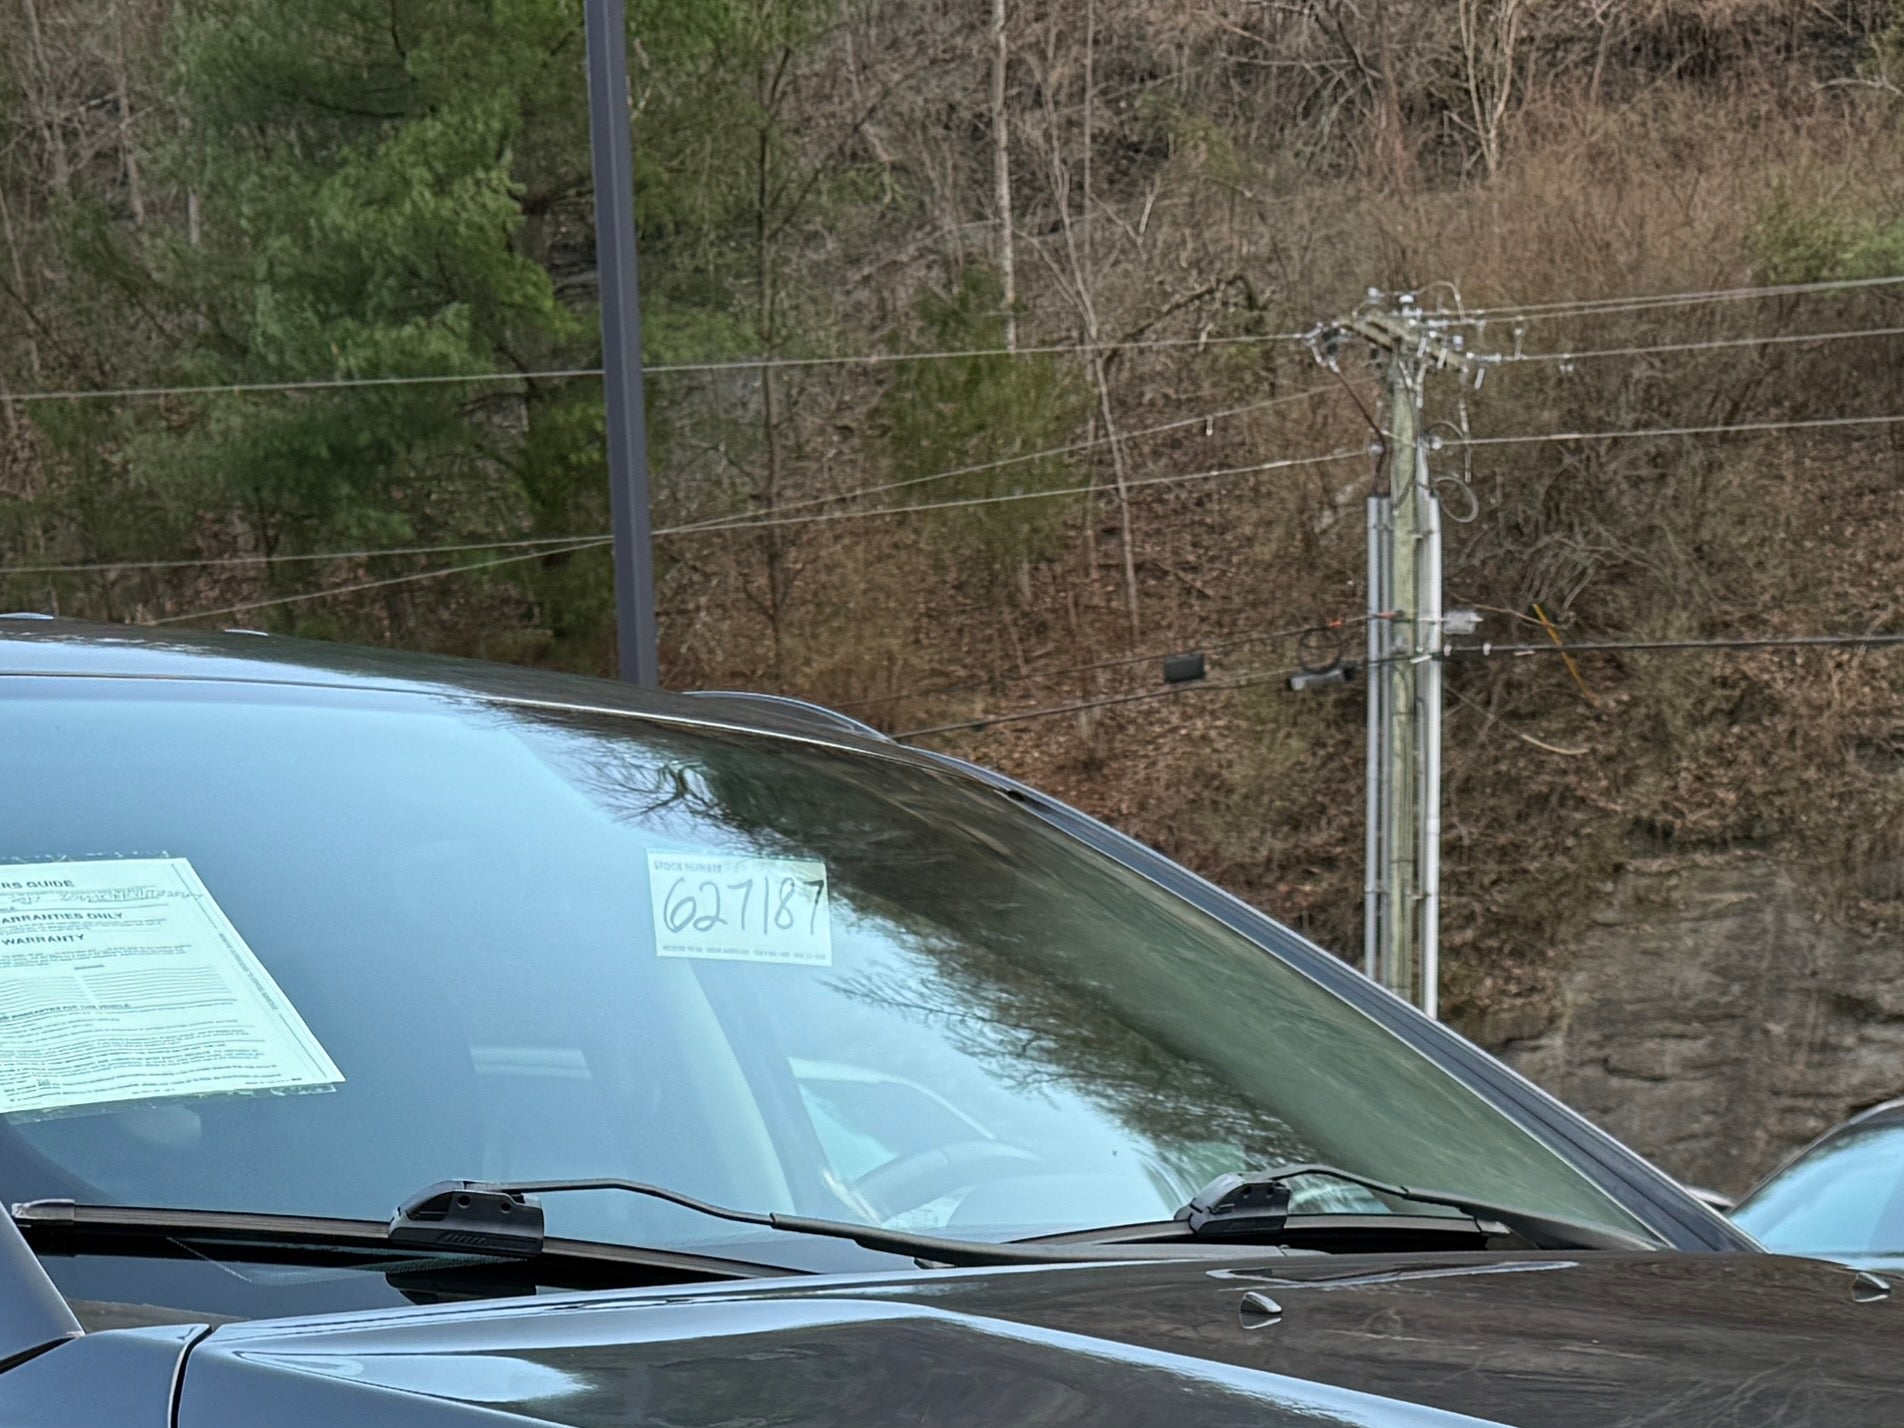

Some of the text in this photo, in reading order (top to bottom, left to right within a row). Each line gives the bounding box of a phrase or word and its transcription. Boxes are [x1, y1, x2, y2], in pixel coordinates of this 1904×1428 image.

[26, 879, 75, 889] GUIDE
[663, 876, 825, 936] 627187
[86, 911, 123, 921] ONLY
[2, 933, 85, 946] WARRANTY
